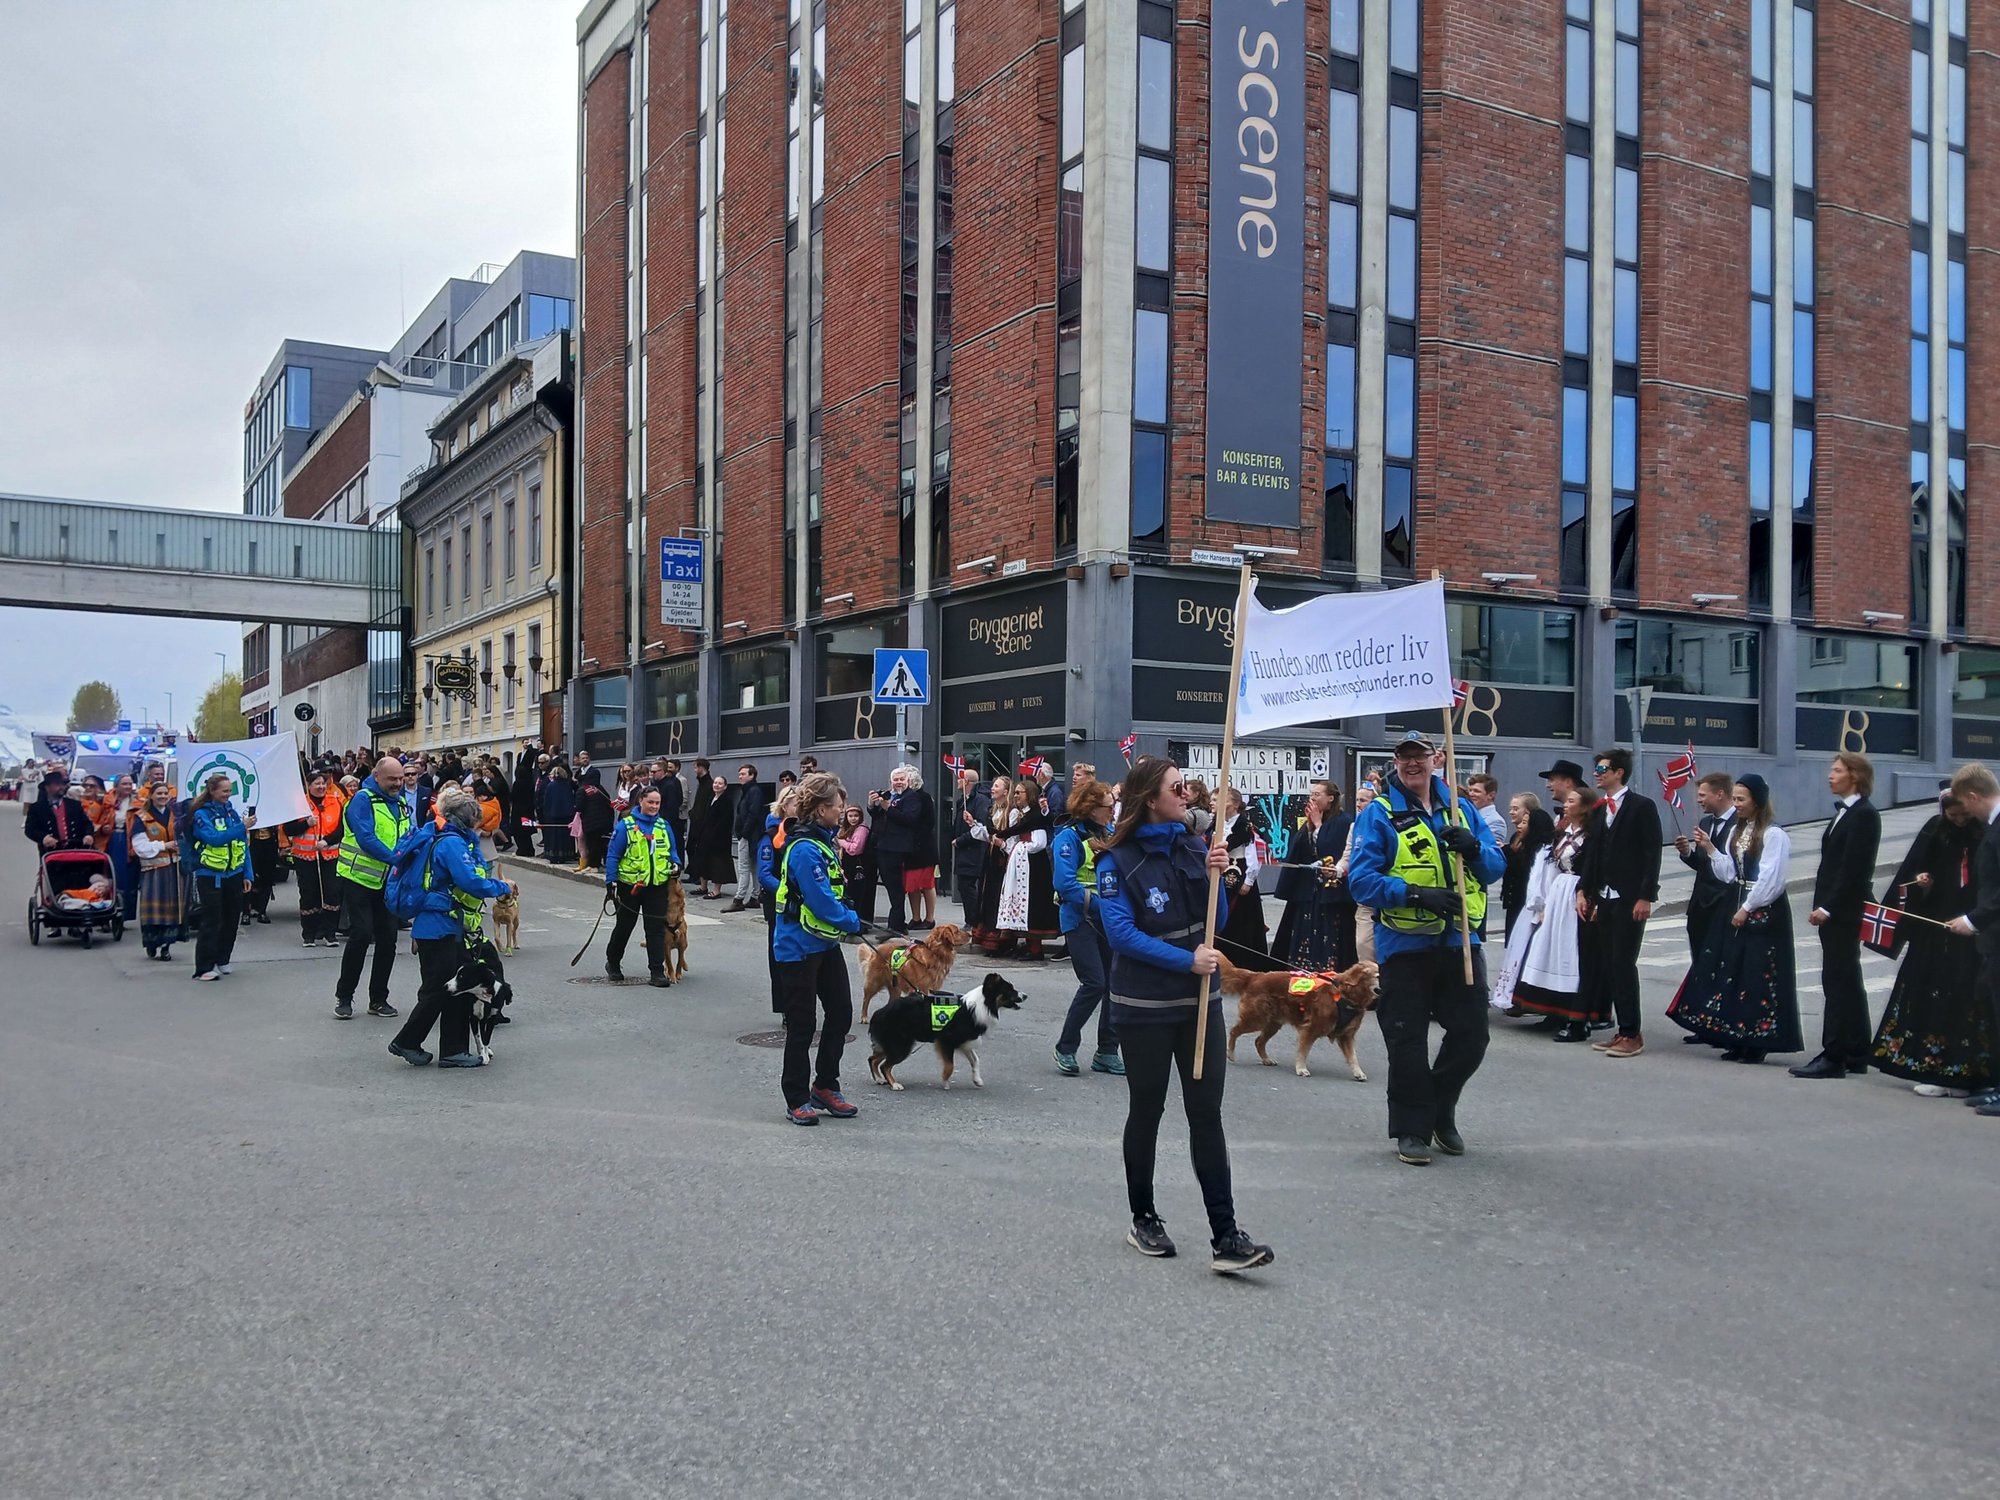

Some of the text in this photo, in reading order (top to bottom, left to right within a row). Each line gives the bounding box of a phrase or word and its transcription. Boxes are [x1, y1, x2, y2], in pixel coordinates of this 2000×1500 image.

[1237, 25, 1279, 258] scene
[1223, 450, 1285, 471] KONSERTER,
[1216, 469, 1290, 490] BAR & EVENTS
[1194, 551, 1242, 565] Peder Hansens gate
[664, 561, 699, 578] Taxi
[969, 605, 1044, 644] Bryggeriet
[995, 634, 1032, 655] scene
[1250, 634, 1429, 679] Hunden som redder liv
[1003, 699, 1014, 710] BAR
[1022, 696, 1042, 708] EVENTS
[1176, 691, 1224, 703] KONSERTER
[1193, 750, 1292, 765] VI VISER
[1287, 775, 1308, 790] VM
